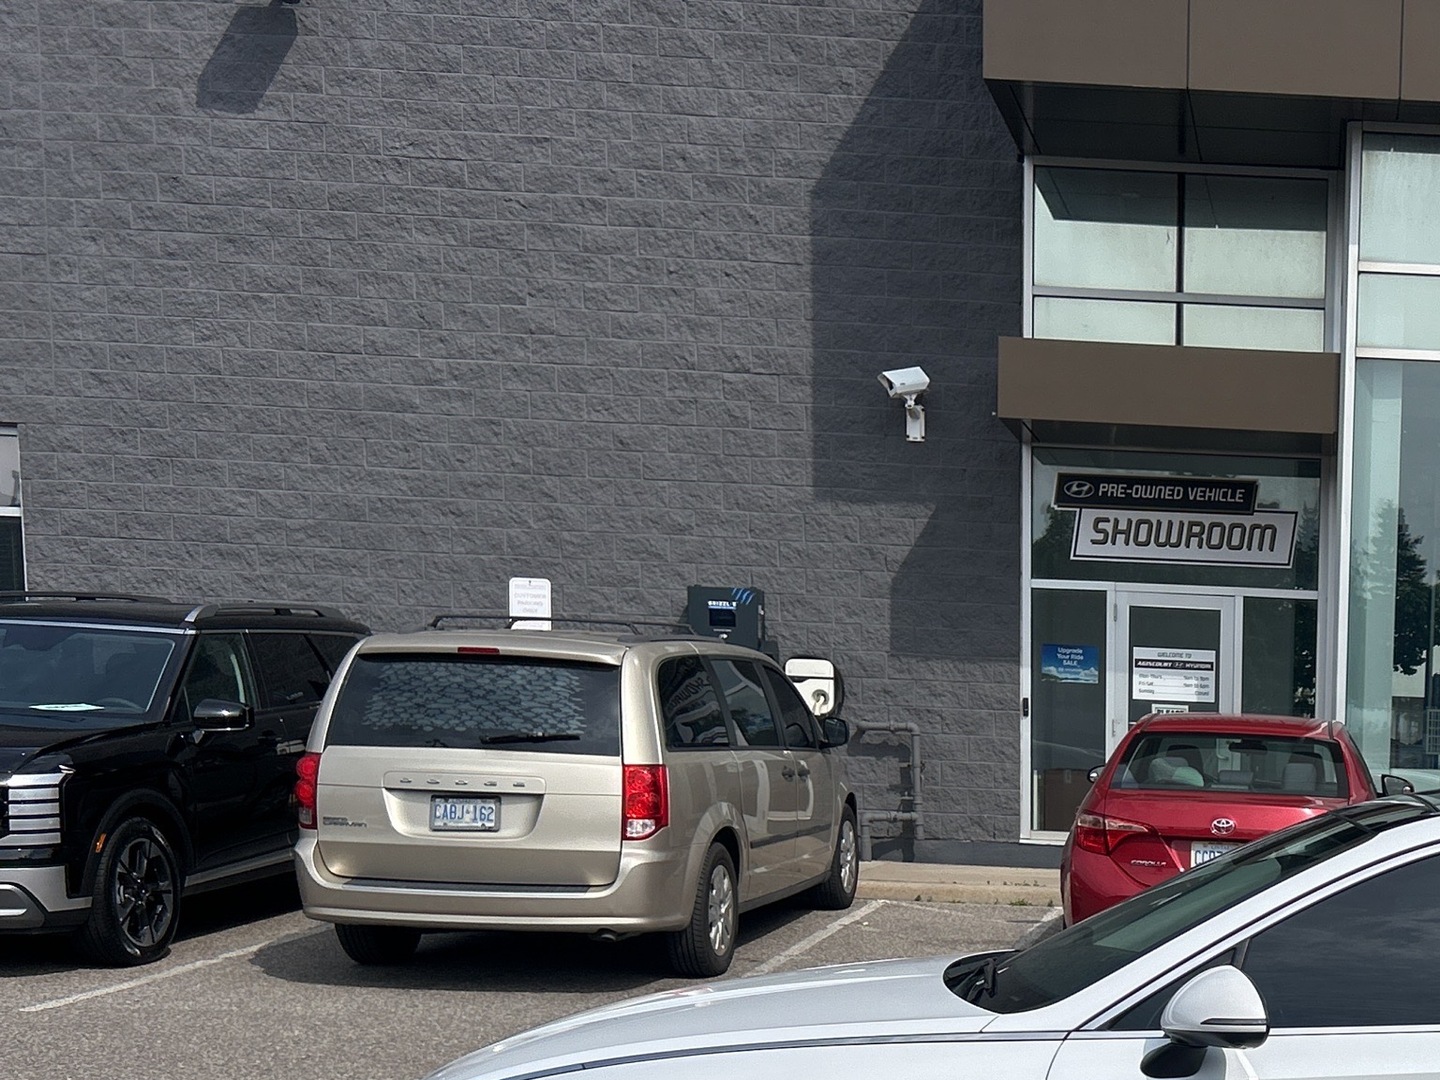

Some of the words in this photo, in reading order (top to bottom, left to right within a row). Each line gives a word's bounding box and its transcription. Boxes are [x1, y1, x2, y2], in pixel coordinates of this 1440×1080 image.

[1099, 483, 1183, 500] PRE-OWNED
[1188, 487, 1245, 502] VEHICLE
[1090, 517, 1278, 552] SHOWROOM
[435, 804, 464, 820] CABJ
[472, 805, 494, 823] 162
